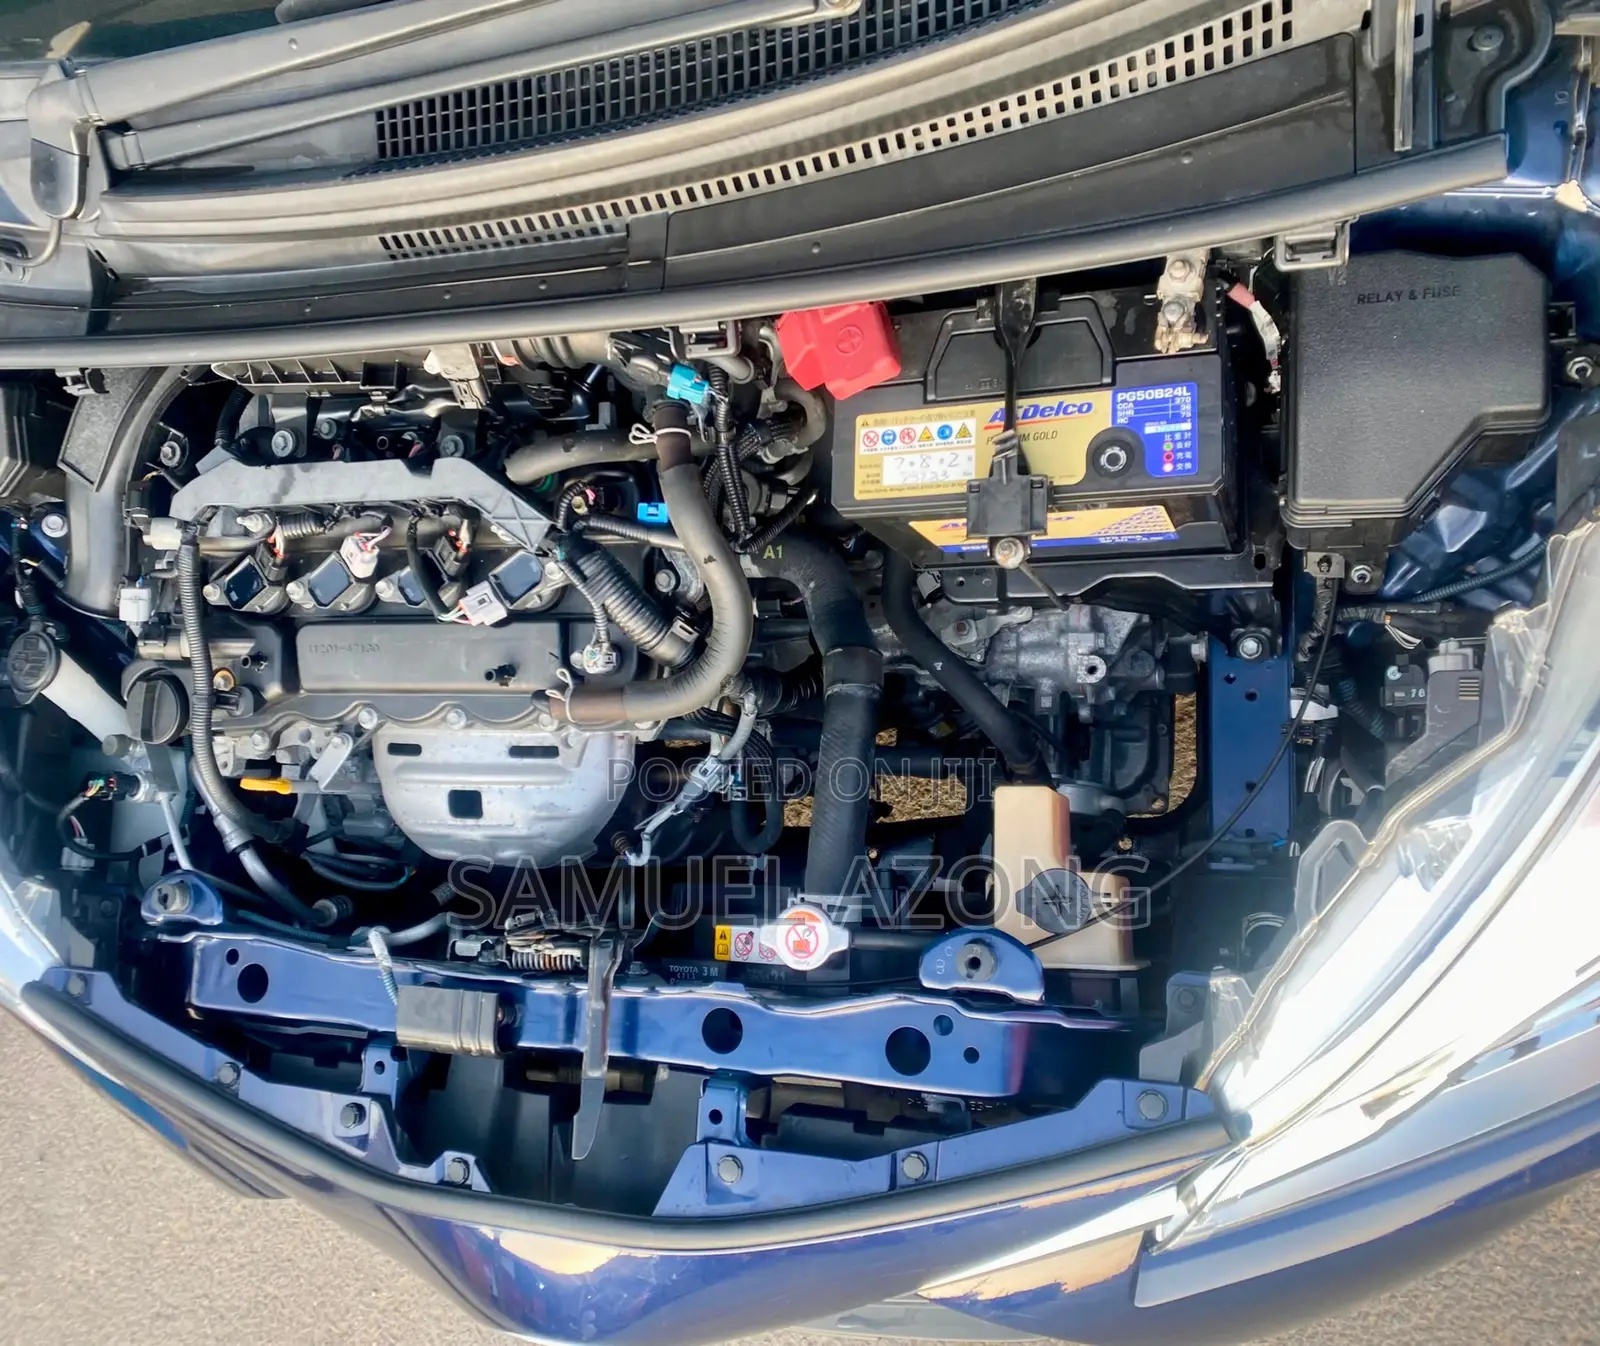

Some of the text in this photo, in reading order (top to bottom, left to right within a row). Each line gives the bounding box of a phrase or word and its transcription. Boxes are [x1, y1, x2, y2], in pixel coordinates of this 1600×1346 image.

[1357, 285, 1461, 305] RELAY & FUSE
[1117, 386, 1191, 403] PG50B24L
[1175, 397, 1191, 405] 370
[988, 400, 1093, 423] ADelco
[1033, 430, 1058, 442] GOLD
[763, 544, 783, 559] A1
[669, 965, 698, 974] TOYOTA
